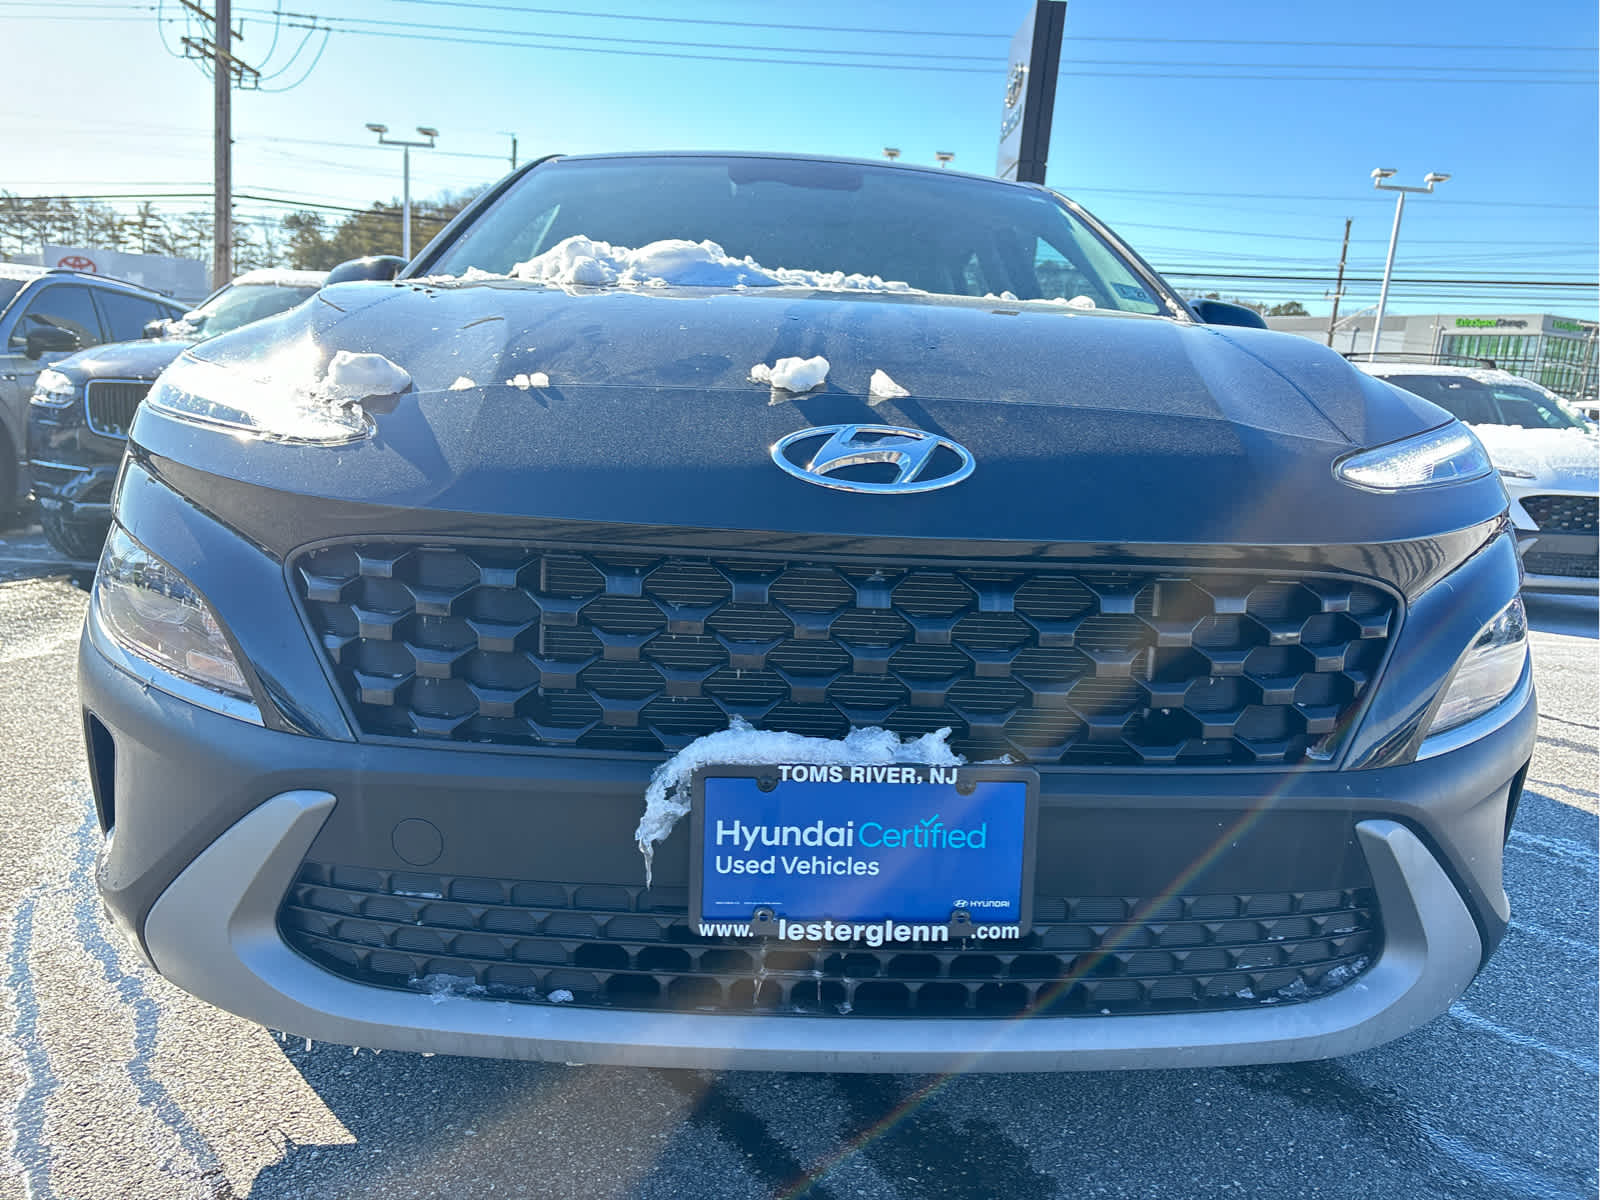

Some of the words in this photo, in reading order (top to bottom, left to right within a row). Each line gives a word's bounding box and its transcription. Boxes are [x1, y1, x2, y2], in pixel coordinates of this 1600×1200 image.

[778, 765, 843, 783] TOMS
[850, 766, 922, 785] RIVER,
[930, 767, 958, 785] NJ
[715, 820, 854, 851] Hyundai
[858, 814, 987, 848] Certified
[715, 855, 776, 874] Used
[781, 856, 880, 876] Vehicles
[969, 900, 1010, 908] HYUNDAI
[699, 923, 754, 938] www.
[778, 919, 949, 947] lesterglenn
[970, 925, 1020, 940] .com
